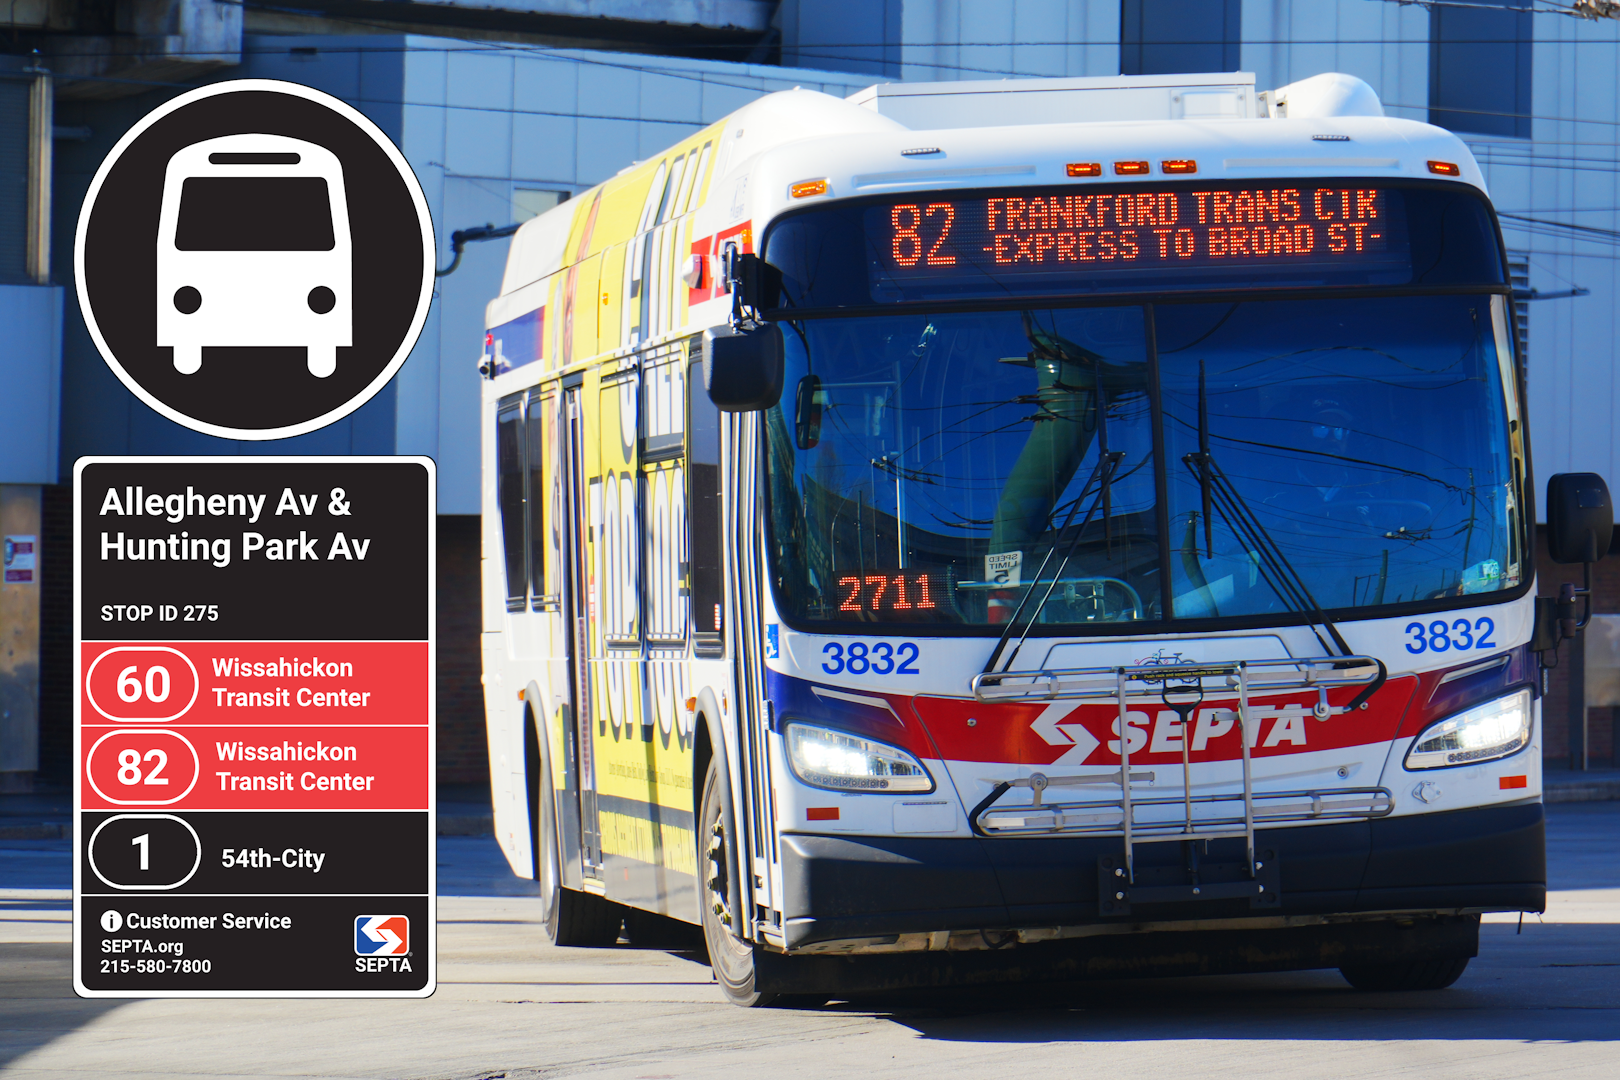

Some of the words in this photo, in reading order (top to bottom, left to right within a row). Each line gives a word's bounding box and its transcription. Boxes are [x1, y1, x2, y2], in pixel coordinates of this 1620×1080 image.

[987, 193, 1179, 231] FRANKFORD
[1191, 188, 1301, 224] TRANS
[892, 203, 956, 266] 82
[983, 230, 1140, 264] -EXPRESS
[1153, 228, 1195, 259] TO
[1208, 224, 1315, 258] BROAD
[1327, 222, 1382, 253] ST-
[839, 575, 935, 611] 2711
[1405, 616, 1496, 655] 3832
[822, 643, 919, 675] 3832
[1107, 703, 1307, 756] SEPTA
